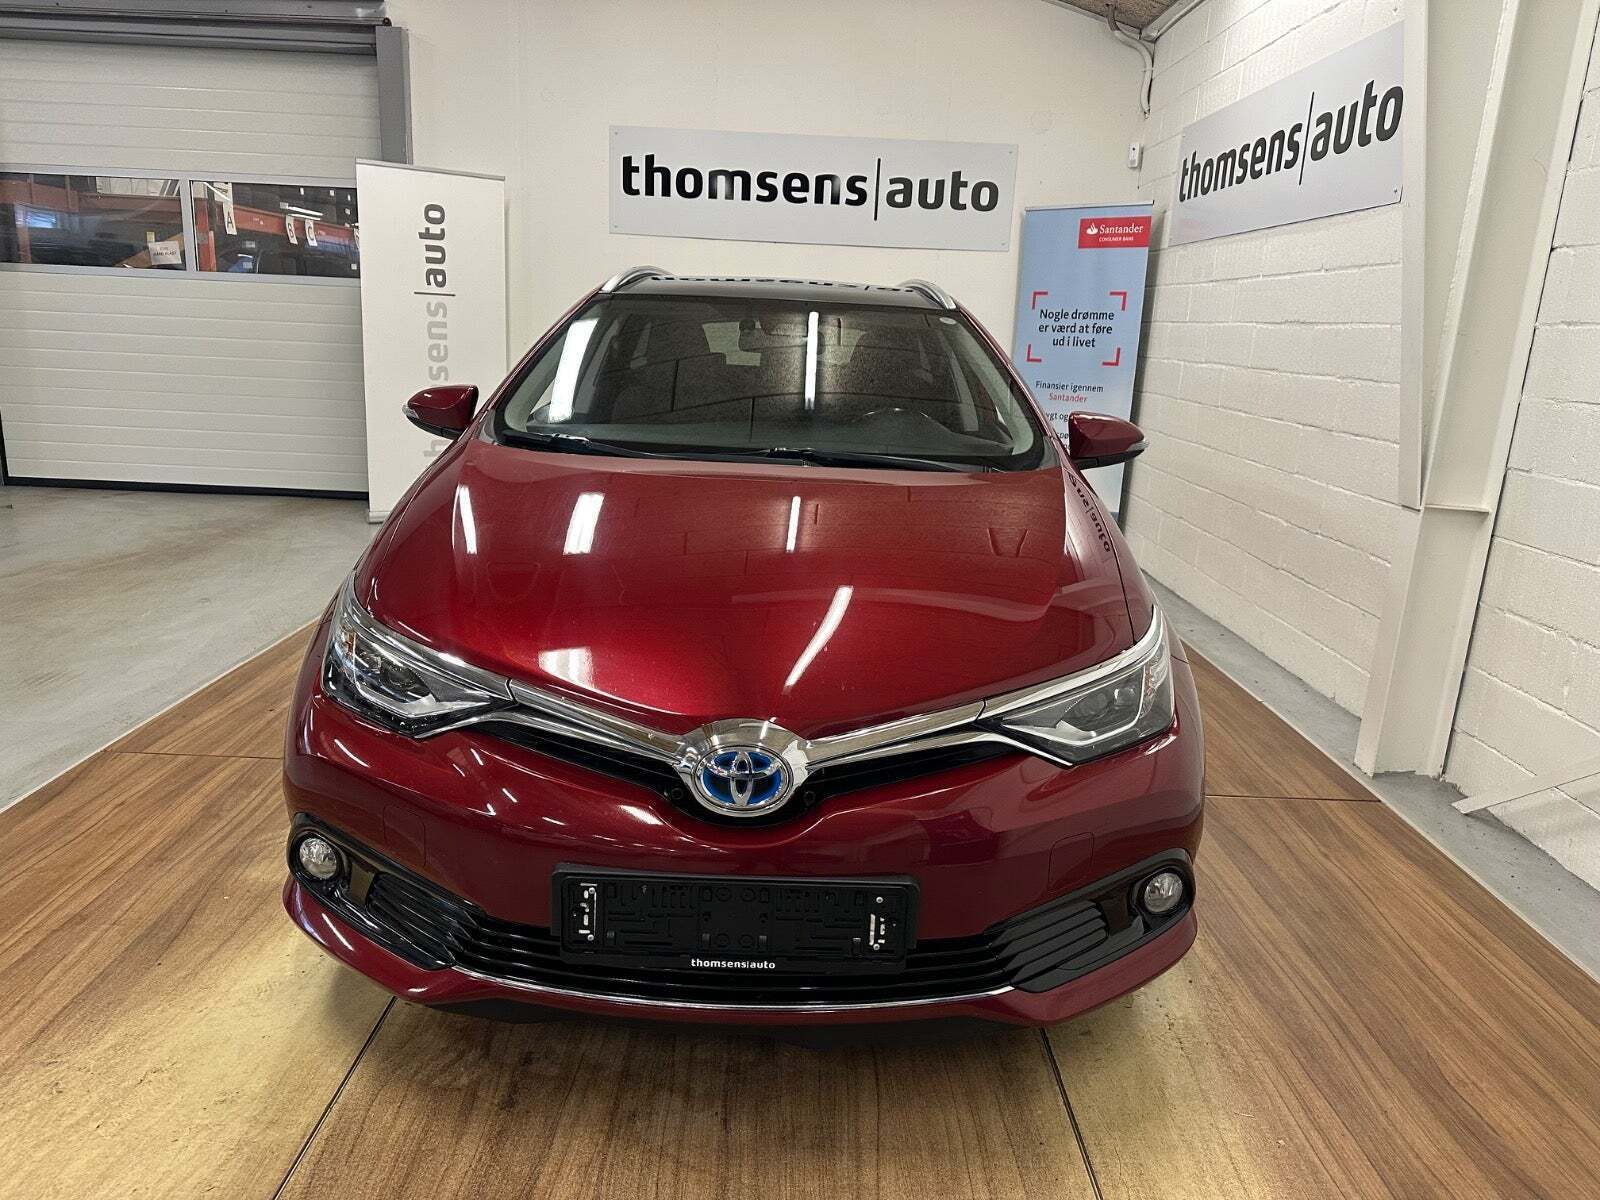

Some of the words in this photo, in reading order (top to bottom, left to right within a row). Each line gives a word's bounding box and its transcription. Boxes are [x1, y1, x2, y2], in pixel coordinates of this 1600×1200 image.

[1100, 222, 1144, 234] Santander
[1040, 308, 1069, 322] Nogle
[1071, 308, 1115, 320] drømme
[1038, 324, 1049, 332] er
[1051, 322, 1076, 333] værd
[1078, 323, 1089, 334] at
[1092, 322, 1113, 334] føre
[1052, 336, 1065, 346] ud
[1072, 336, 1096, 348] livet
[1035, 380, 1069, 391] Finansier
[1070, 382, 1104, 393] igennem
[1049, 393, 1088, 403] Santander
